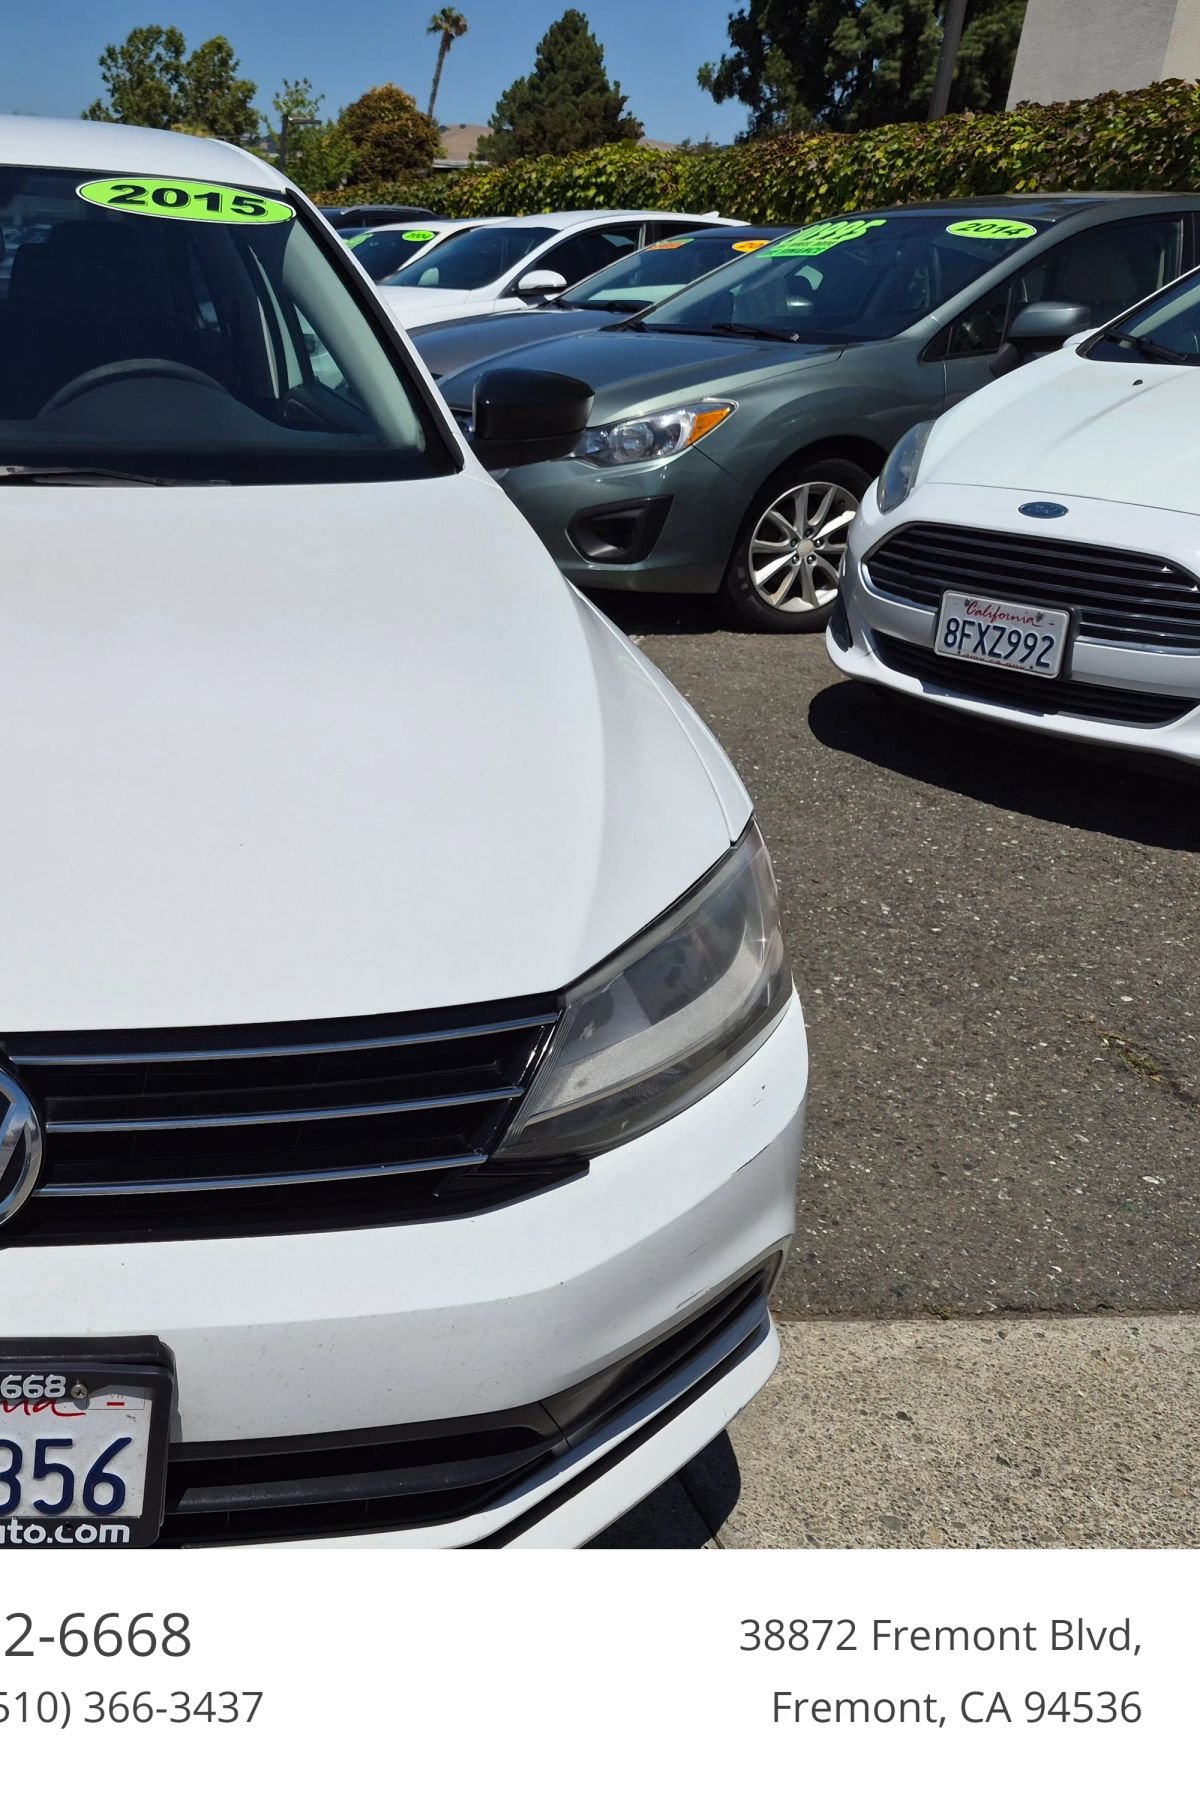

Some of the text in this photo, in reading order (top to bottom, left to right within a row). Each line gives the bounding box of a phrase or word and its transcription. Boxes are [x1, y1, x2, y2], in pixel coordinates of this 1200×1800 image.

[107, 184, 267, 217] 2015
[956, 223, 1028, 236] 2014
[965, 601, 1044, 628] California
[943, 617, 1056, 669] 8FXZ992
